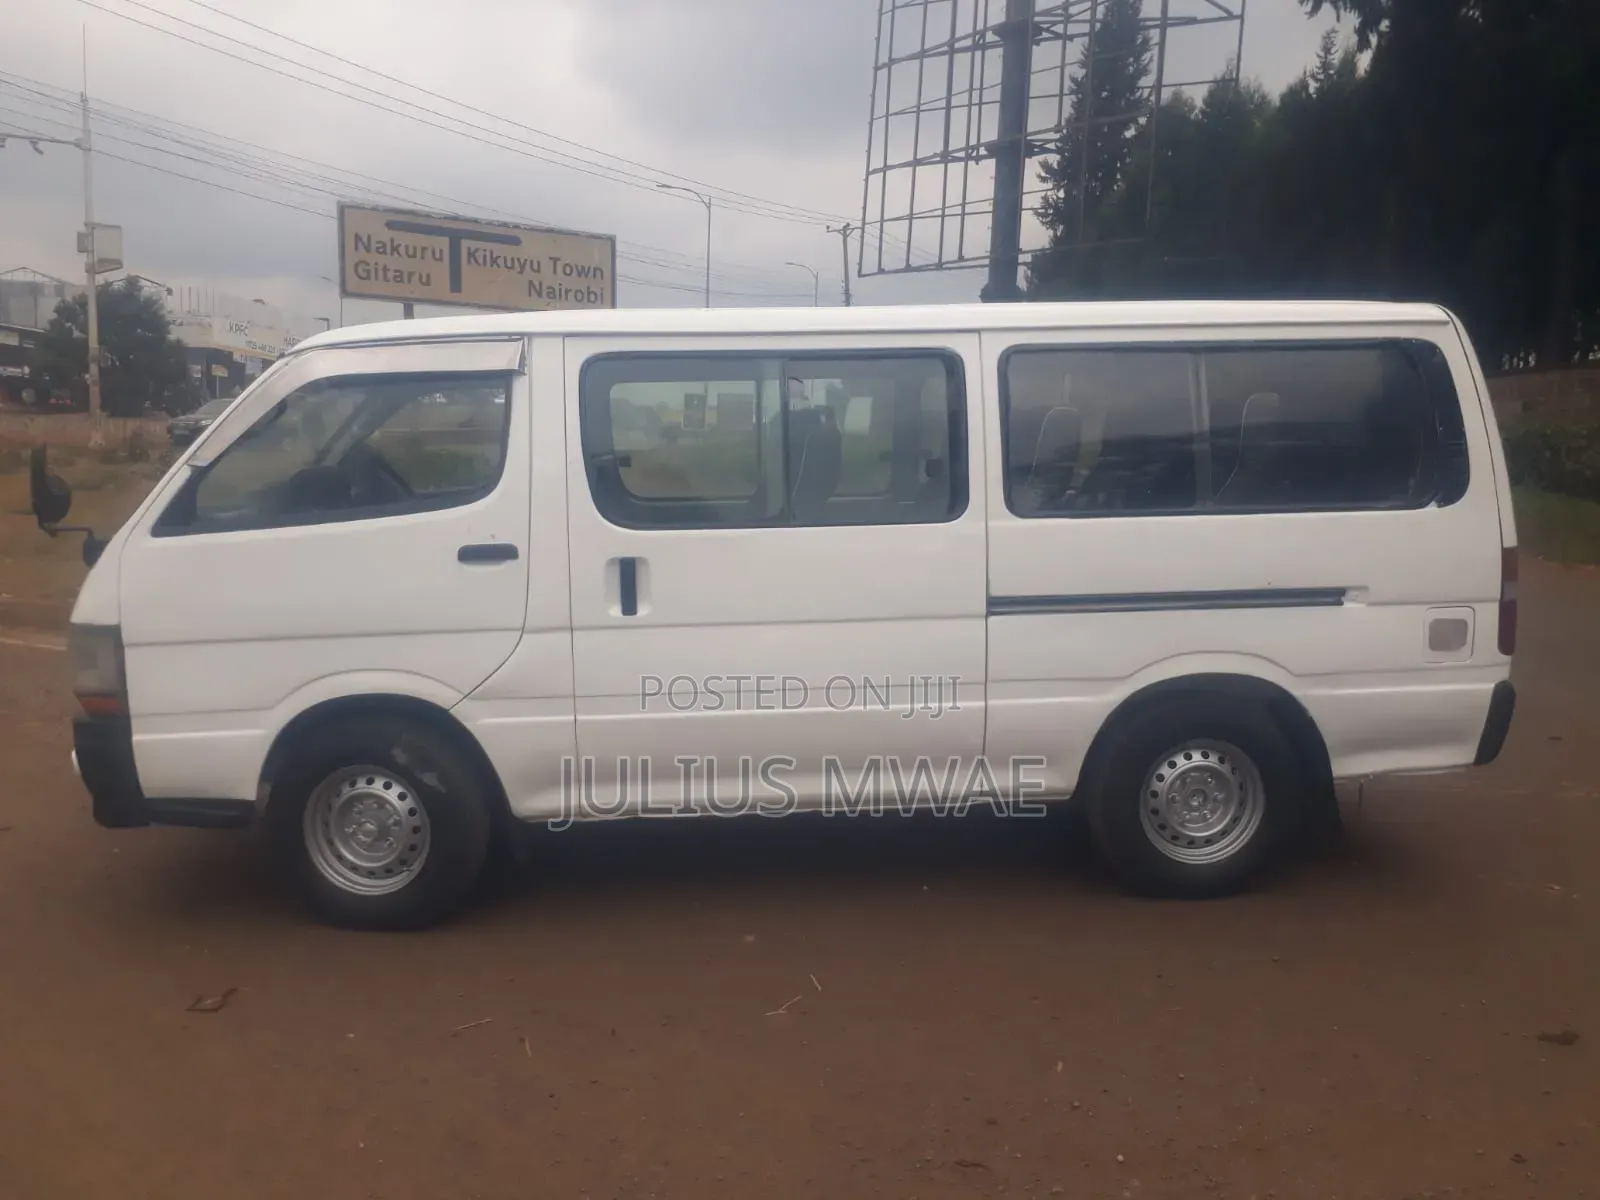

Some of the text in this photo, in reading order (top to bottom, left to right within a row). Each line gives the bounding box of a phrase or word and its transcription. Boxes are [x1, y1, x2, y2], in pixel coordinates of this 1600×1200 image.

[354, 232, 444, 262] Nakuru
[353, 260, 431, 287] Gitaru
[466, 246, 604, 280] Kikuyu Town
[528, 279, 604, 305] Nairobi
